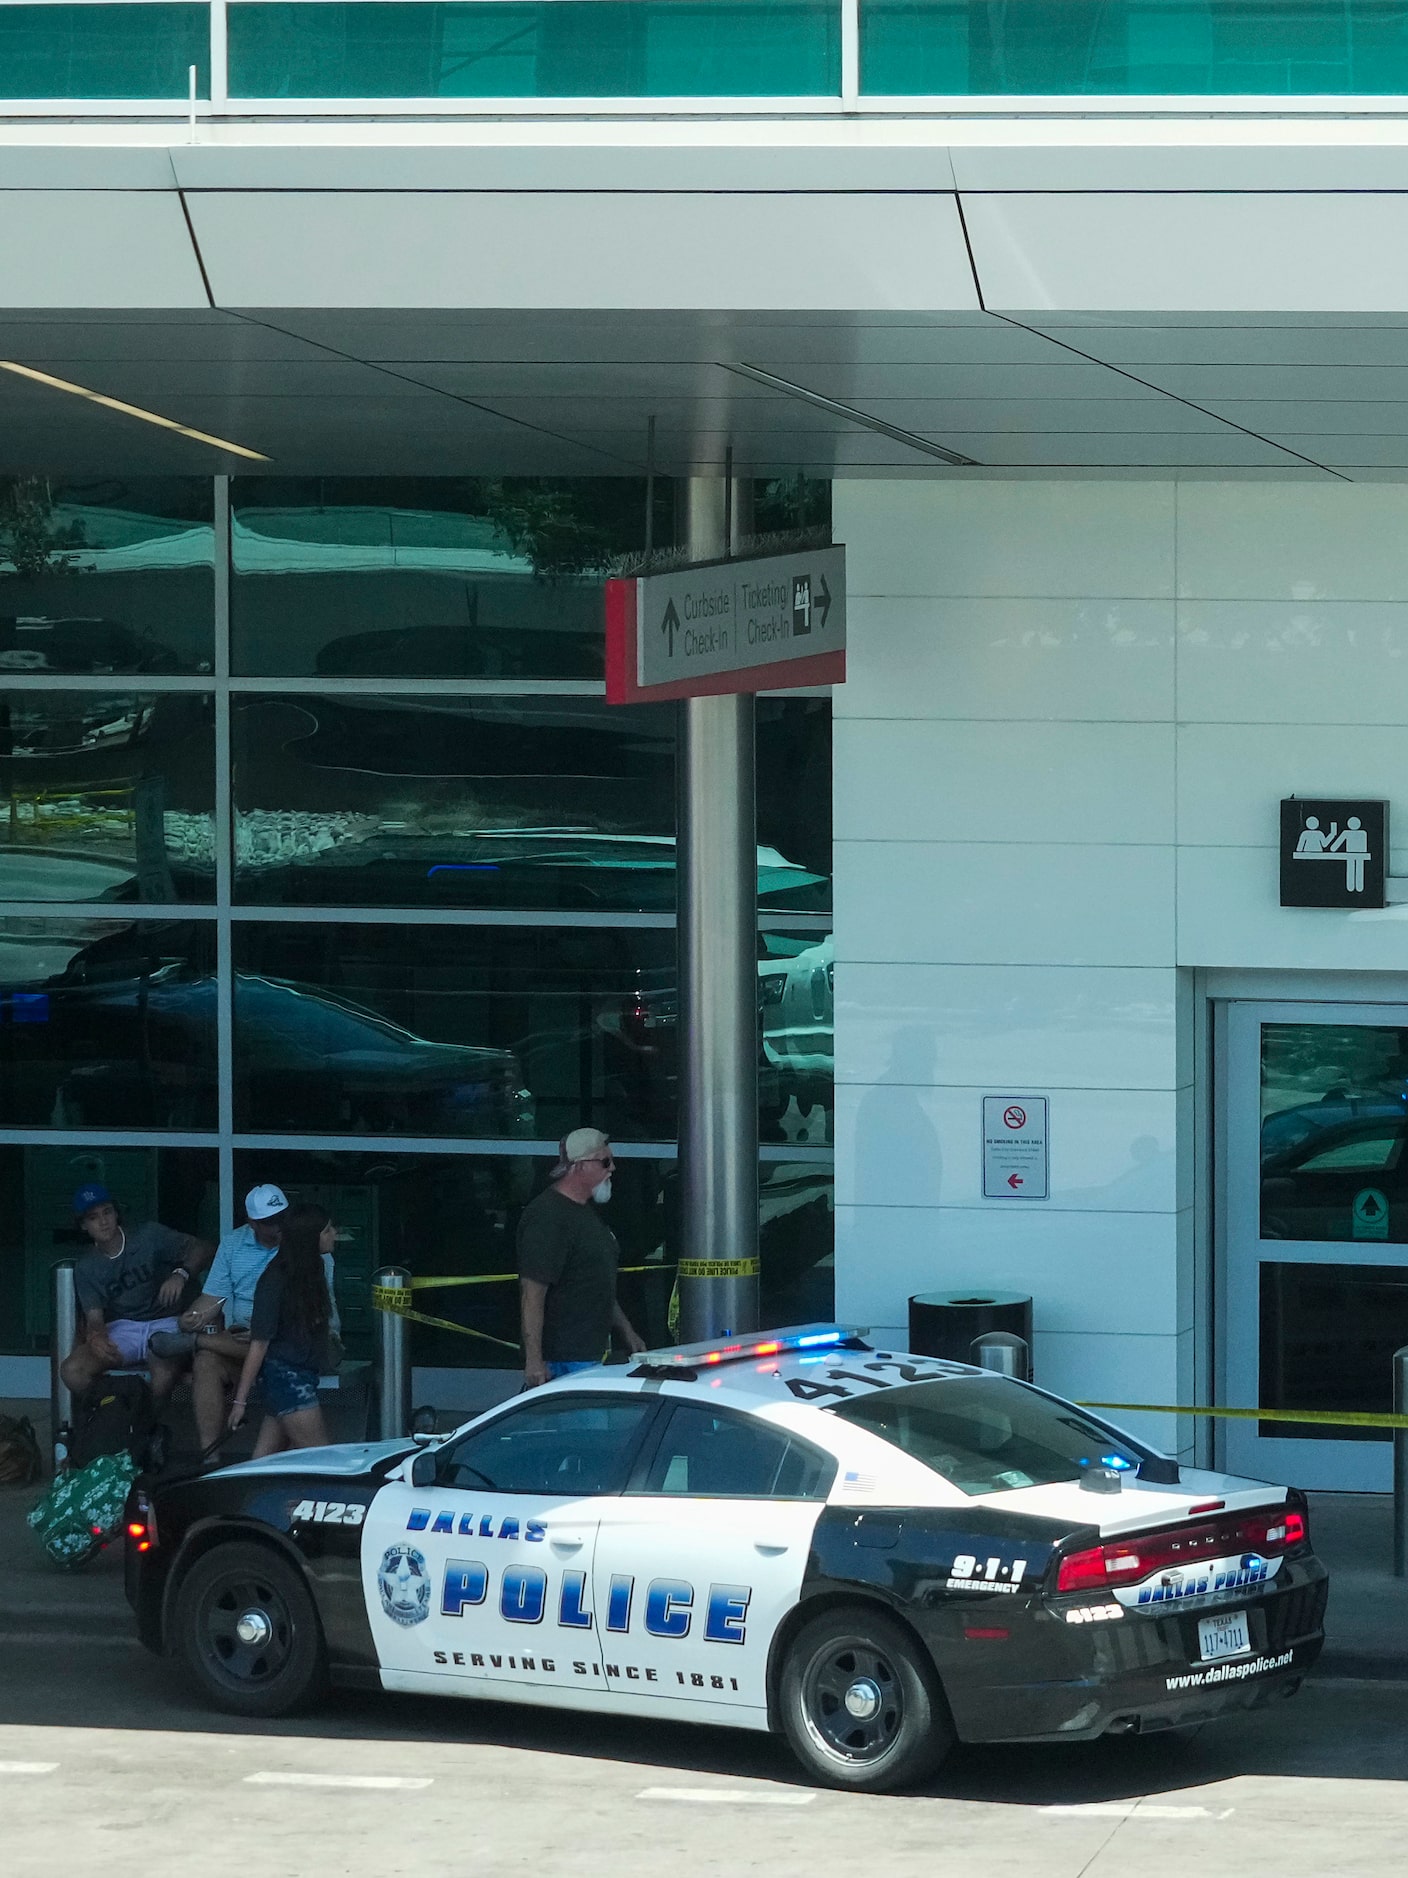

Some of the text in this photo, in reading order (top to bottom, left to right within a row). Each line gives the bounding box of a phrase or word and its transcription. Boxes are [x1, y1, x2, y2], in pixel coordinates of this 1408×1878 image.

[684, 589, 729, 620] Curbside
[684, 624, 728, 657] Check-In
[747, 613, 790, 645] Check-In
[784, 1358, 983, 1400] 4123
[292, 1500, 366, 1525] 4123
[406, 1507, 548, 1542] DALLAS
[946, 1578, 1020, 1593] EMERGENCY
[1137, 1562, 1269, 1604] DALLAS POLICE
[440, 1558, 752, 1645] POLICE
[1065, 1603, 1125, 1624] 4123
[1212, 1616, 1233, 1627] TEXAS
[433, 1651, 739, 1691] SERVING SINCE 1881
[1166, 1649, 1294, 1690] www.dallaspolice.net
